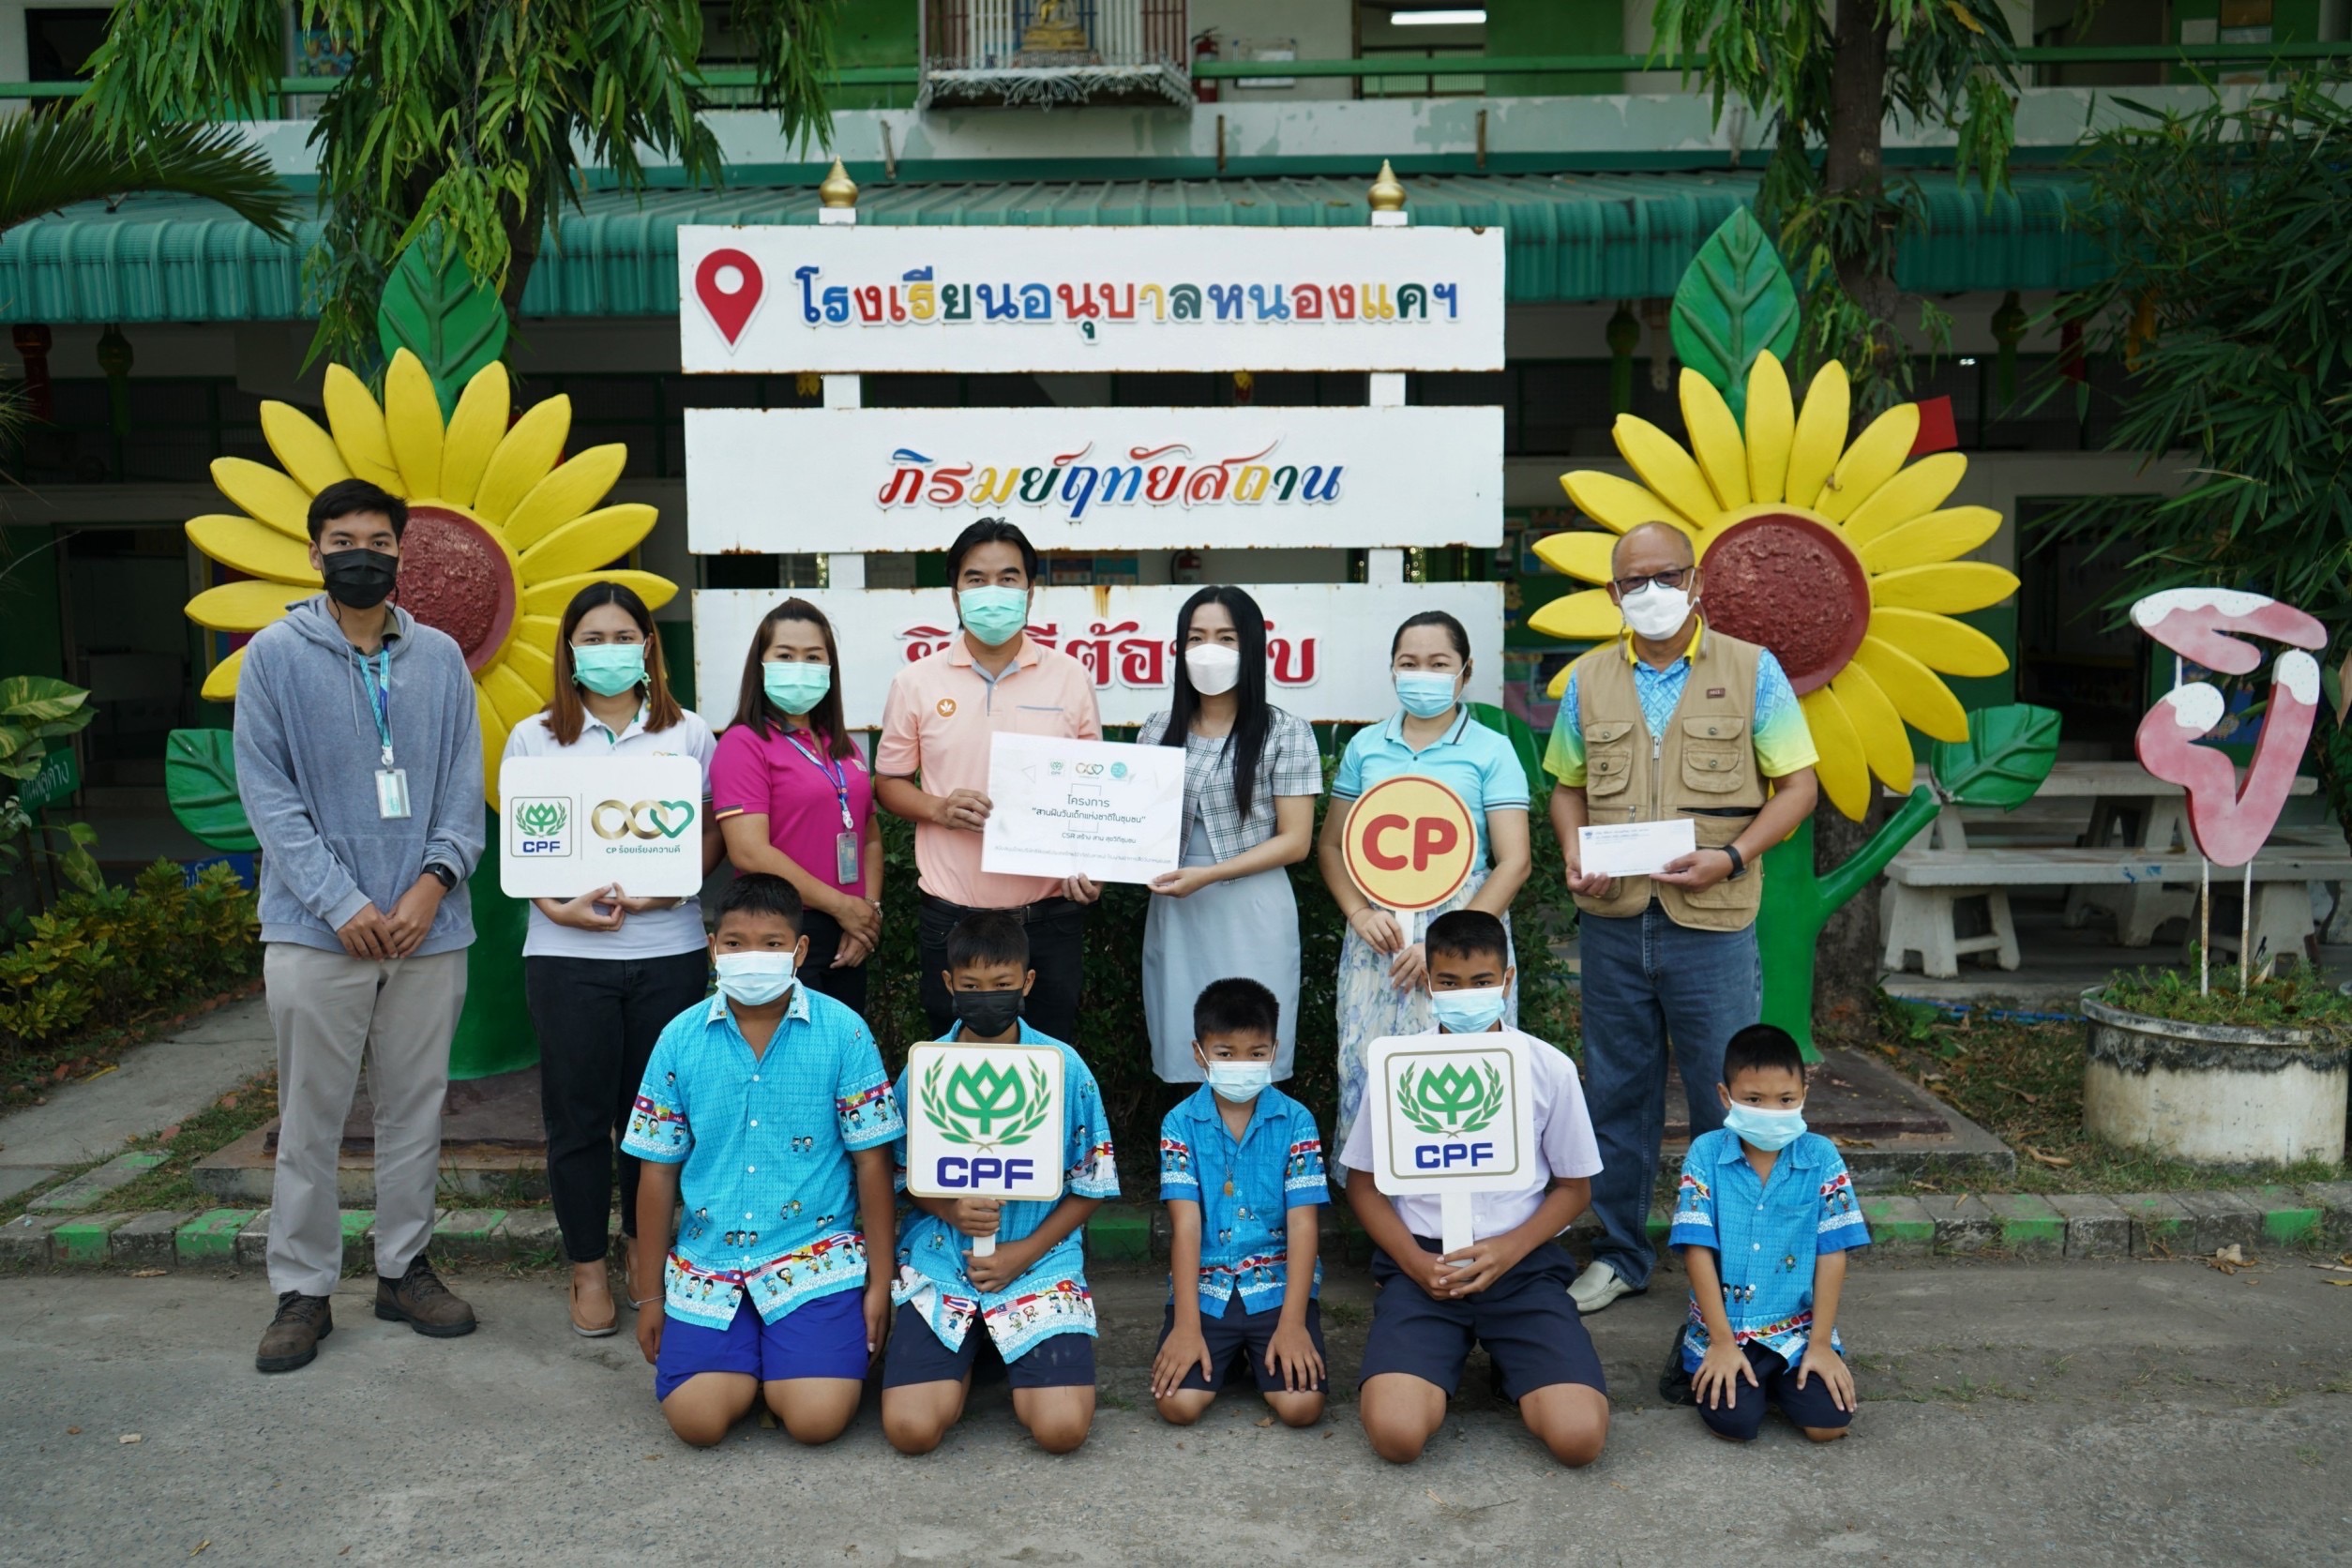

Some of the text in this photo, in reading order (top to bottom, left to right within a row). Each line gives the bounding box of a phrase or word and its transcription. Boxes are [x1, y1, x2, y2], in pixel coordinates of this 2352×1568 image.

[794, 265, 1458, 339] โรงเรียนอนุบาลหนองแคฯ
[878, 438, 1344, 519] ภิรมย์ฤทัยสถาน
[1067, 793, 1110, 808] โครงการ
[522, 840, 561, 853] CPF
[605, 843, 682, 854] CP ร้อยเรียงความดี
[1061, 832, 1076, 840] CSR
[1362, 813, 1458, 871] CP
[1415, 1142, 1494, 1170] CPF
[937, 1156, 1034, 1189] CPF
